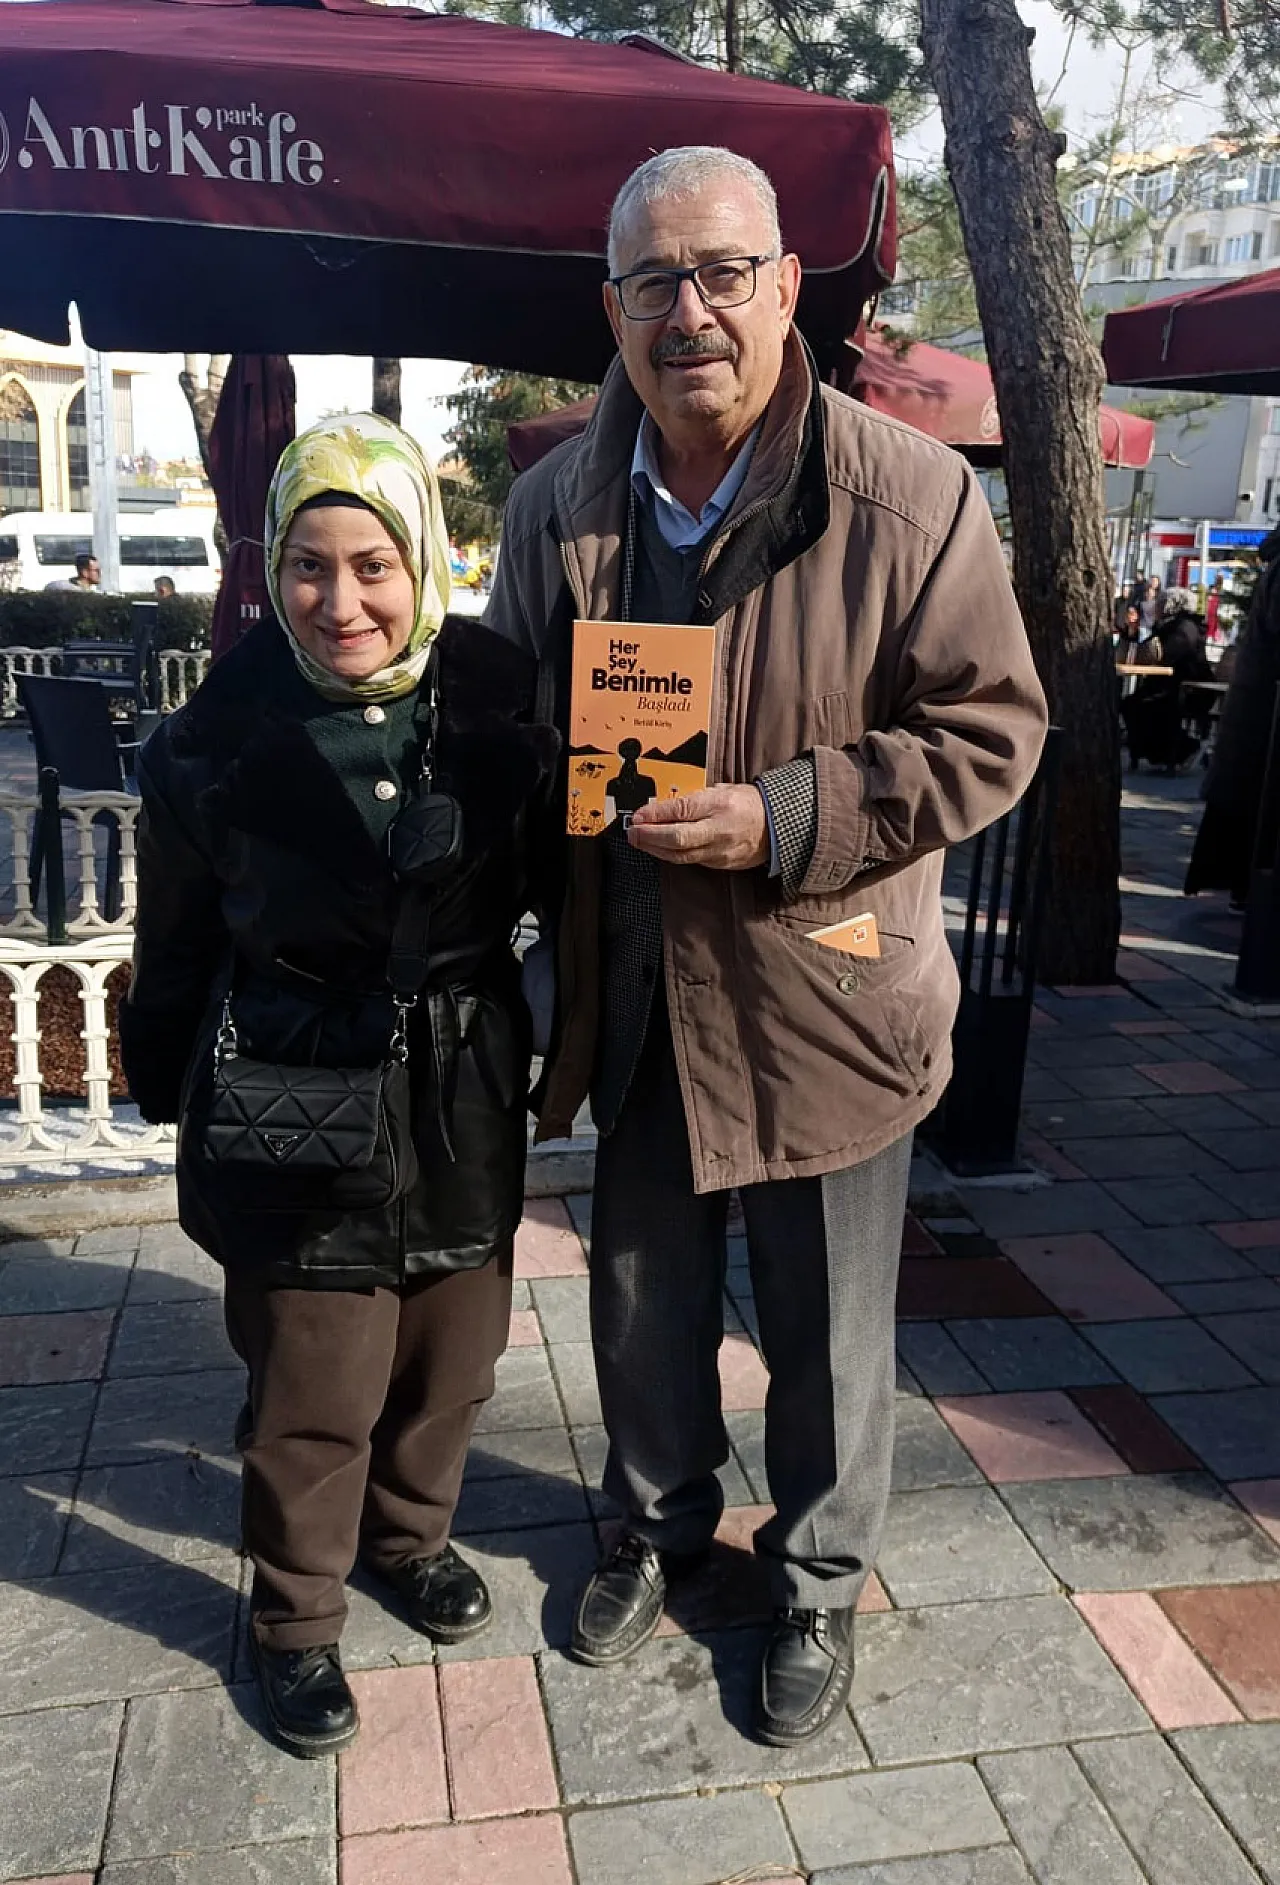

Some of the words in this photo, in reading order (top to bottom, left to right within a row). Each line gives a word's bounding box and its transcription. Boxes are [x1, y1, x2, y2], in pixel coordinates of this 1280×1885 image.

[216, 101, 264, 131] park
[609, 639, 640, 654] Her
[609, 654, 637, 673] Şey
[592, 668, 693, 694] Benimle
[637, 696, 691, 713] Başladı
